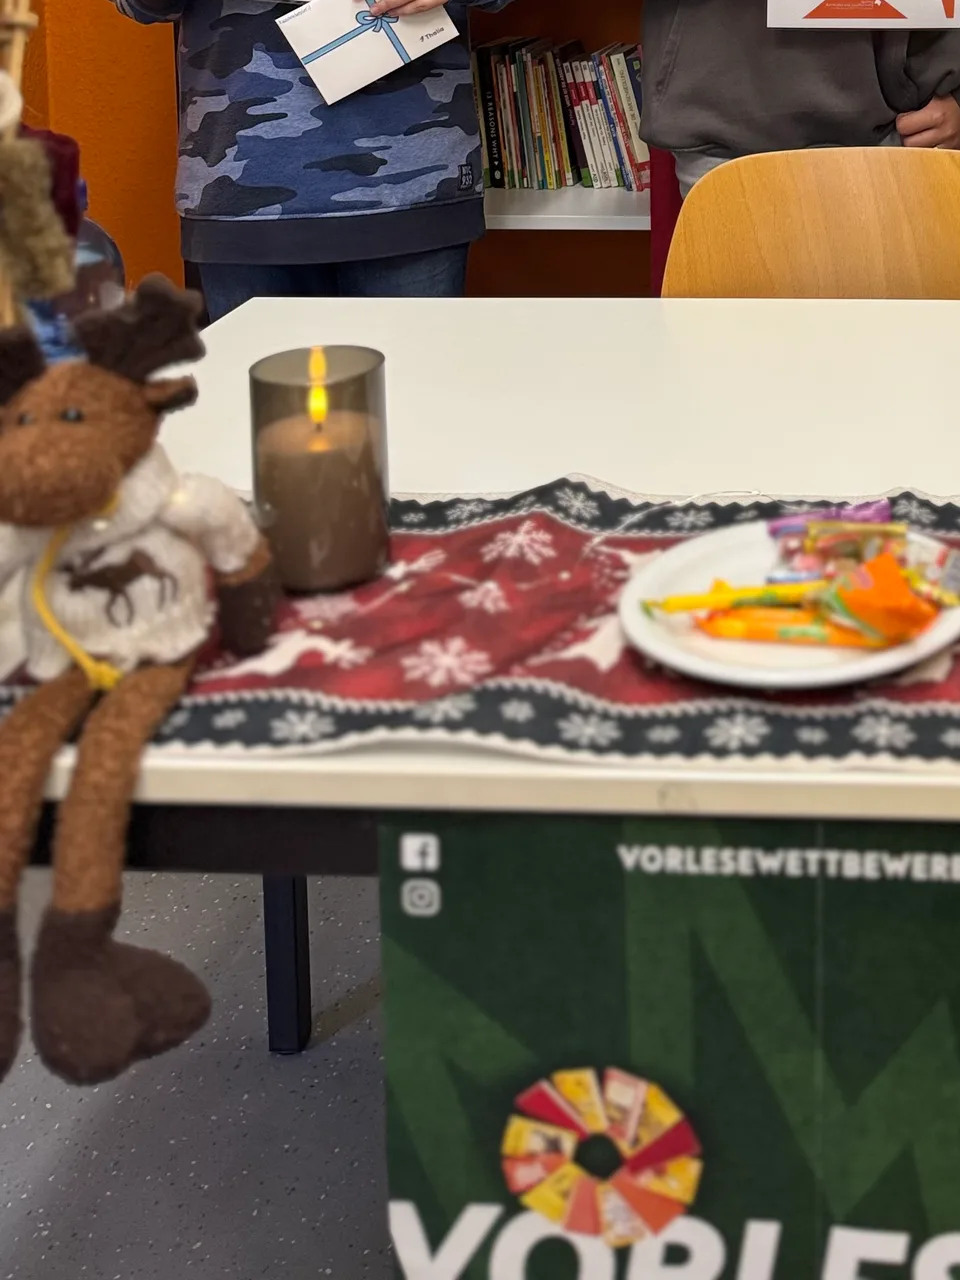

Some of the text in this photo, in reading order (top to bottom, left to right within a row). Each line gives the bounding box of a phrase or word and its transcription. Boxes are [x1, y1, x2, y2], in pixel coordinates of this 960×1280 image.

[425, 26, 445, 40] Thalia
[487, 103, 496, 139] REASONS
[490, 140, 498, 160] WHY
